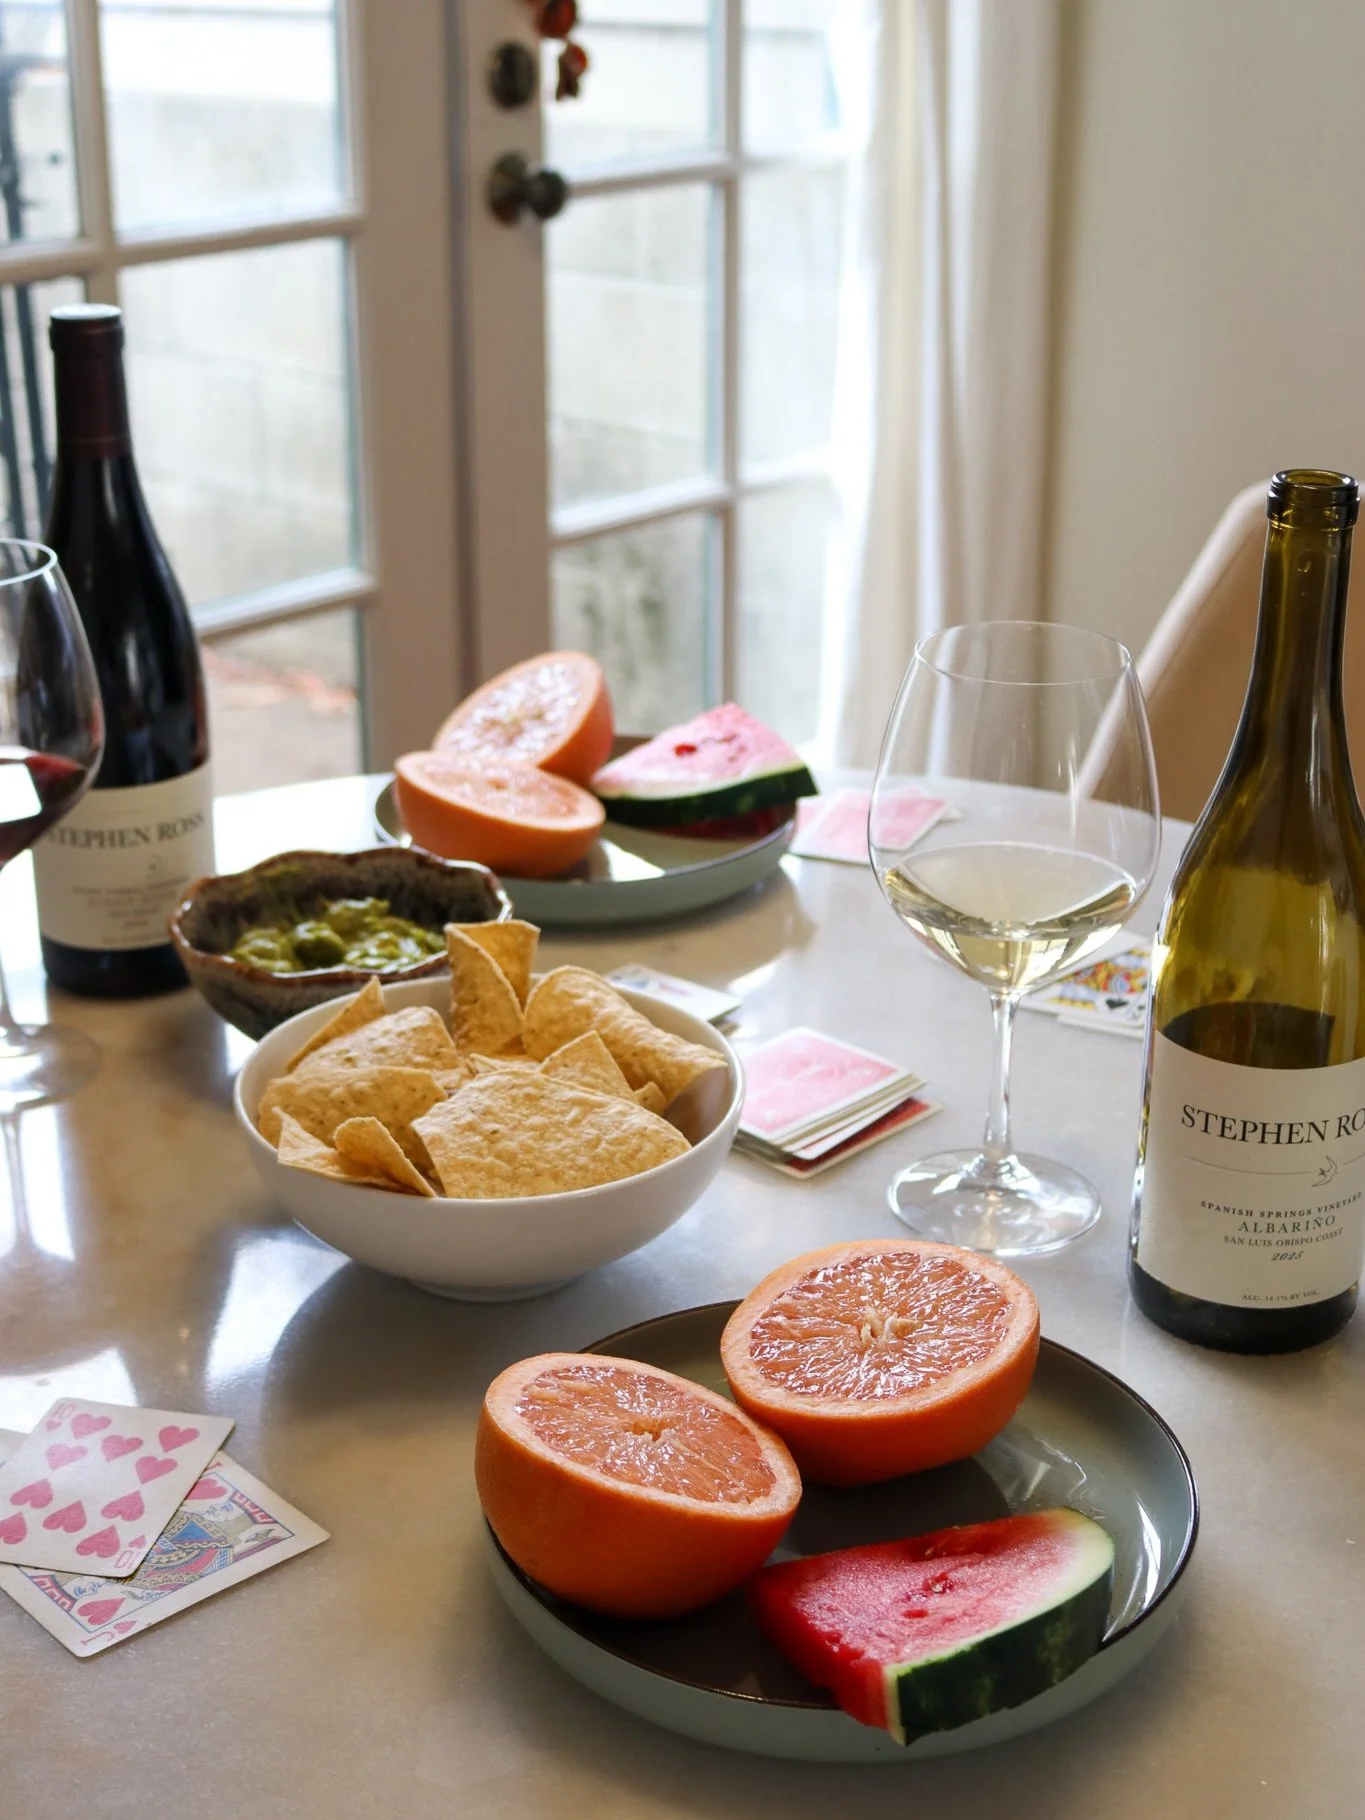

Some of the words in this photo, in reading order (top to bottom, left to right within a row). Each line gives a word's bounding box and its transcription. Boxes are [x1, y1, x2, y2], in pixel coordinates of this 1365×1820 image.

[1181, 1104, 1330, 1145] STEPHEN
[1200, 1200, 1253, 1217] SPANISH
[1259, 1208, 1312, 1218] SPRINGS
[1316, 1191, 1362, 1213] VINEYARD
[1238, 1215, 1336, 1233] ALBARIÑO
[1223, 1235, 1245, 1245] SAN
[1248, 1238, 1273, 1247] LUIS
[1276, 1236, 1313, 1247] OBISPO
[1315, 1227, 1344, 1242] COAST
